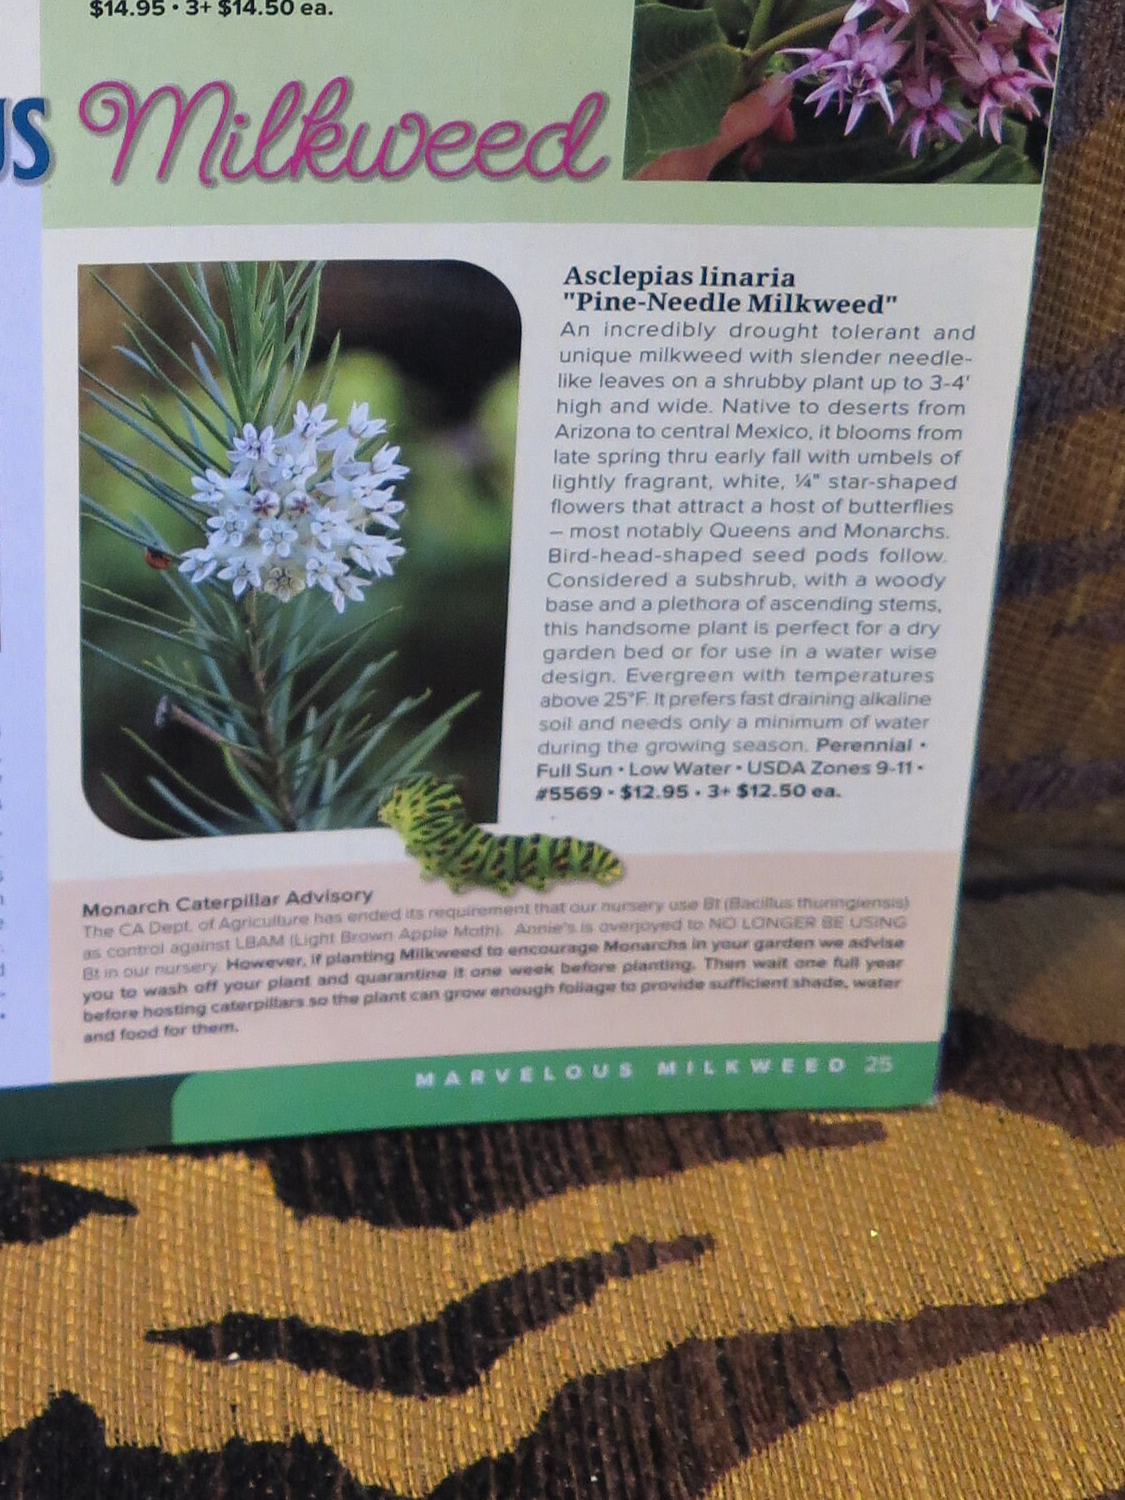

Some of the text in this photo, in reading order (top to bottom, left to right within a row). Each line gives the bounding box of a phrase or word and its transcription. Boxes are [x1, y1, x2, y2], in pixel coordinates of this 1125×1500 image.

[300, 2, 333, 16] ea.
[78, 76, 610, 187] Milkweed
[563, 264, 795, 290] Asclepias linaria
[564, 291, 897, 314] "Pine-Needle Milkweed"
[559, 346, 972, 367] unique milkweed with slender needle-
[620, 784, 689, 800] $12.95
[736, 782, 806, 799] $12.50
[82, 889, 374, 917] Monarch Caterpillar Advisory
[83, 1022, 239, 1044] and food for them.
[415, 1056, 894, 1088] MARVELOUS MILKWEED 25
